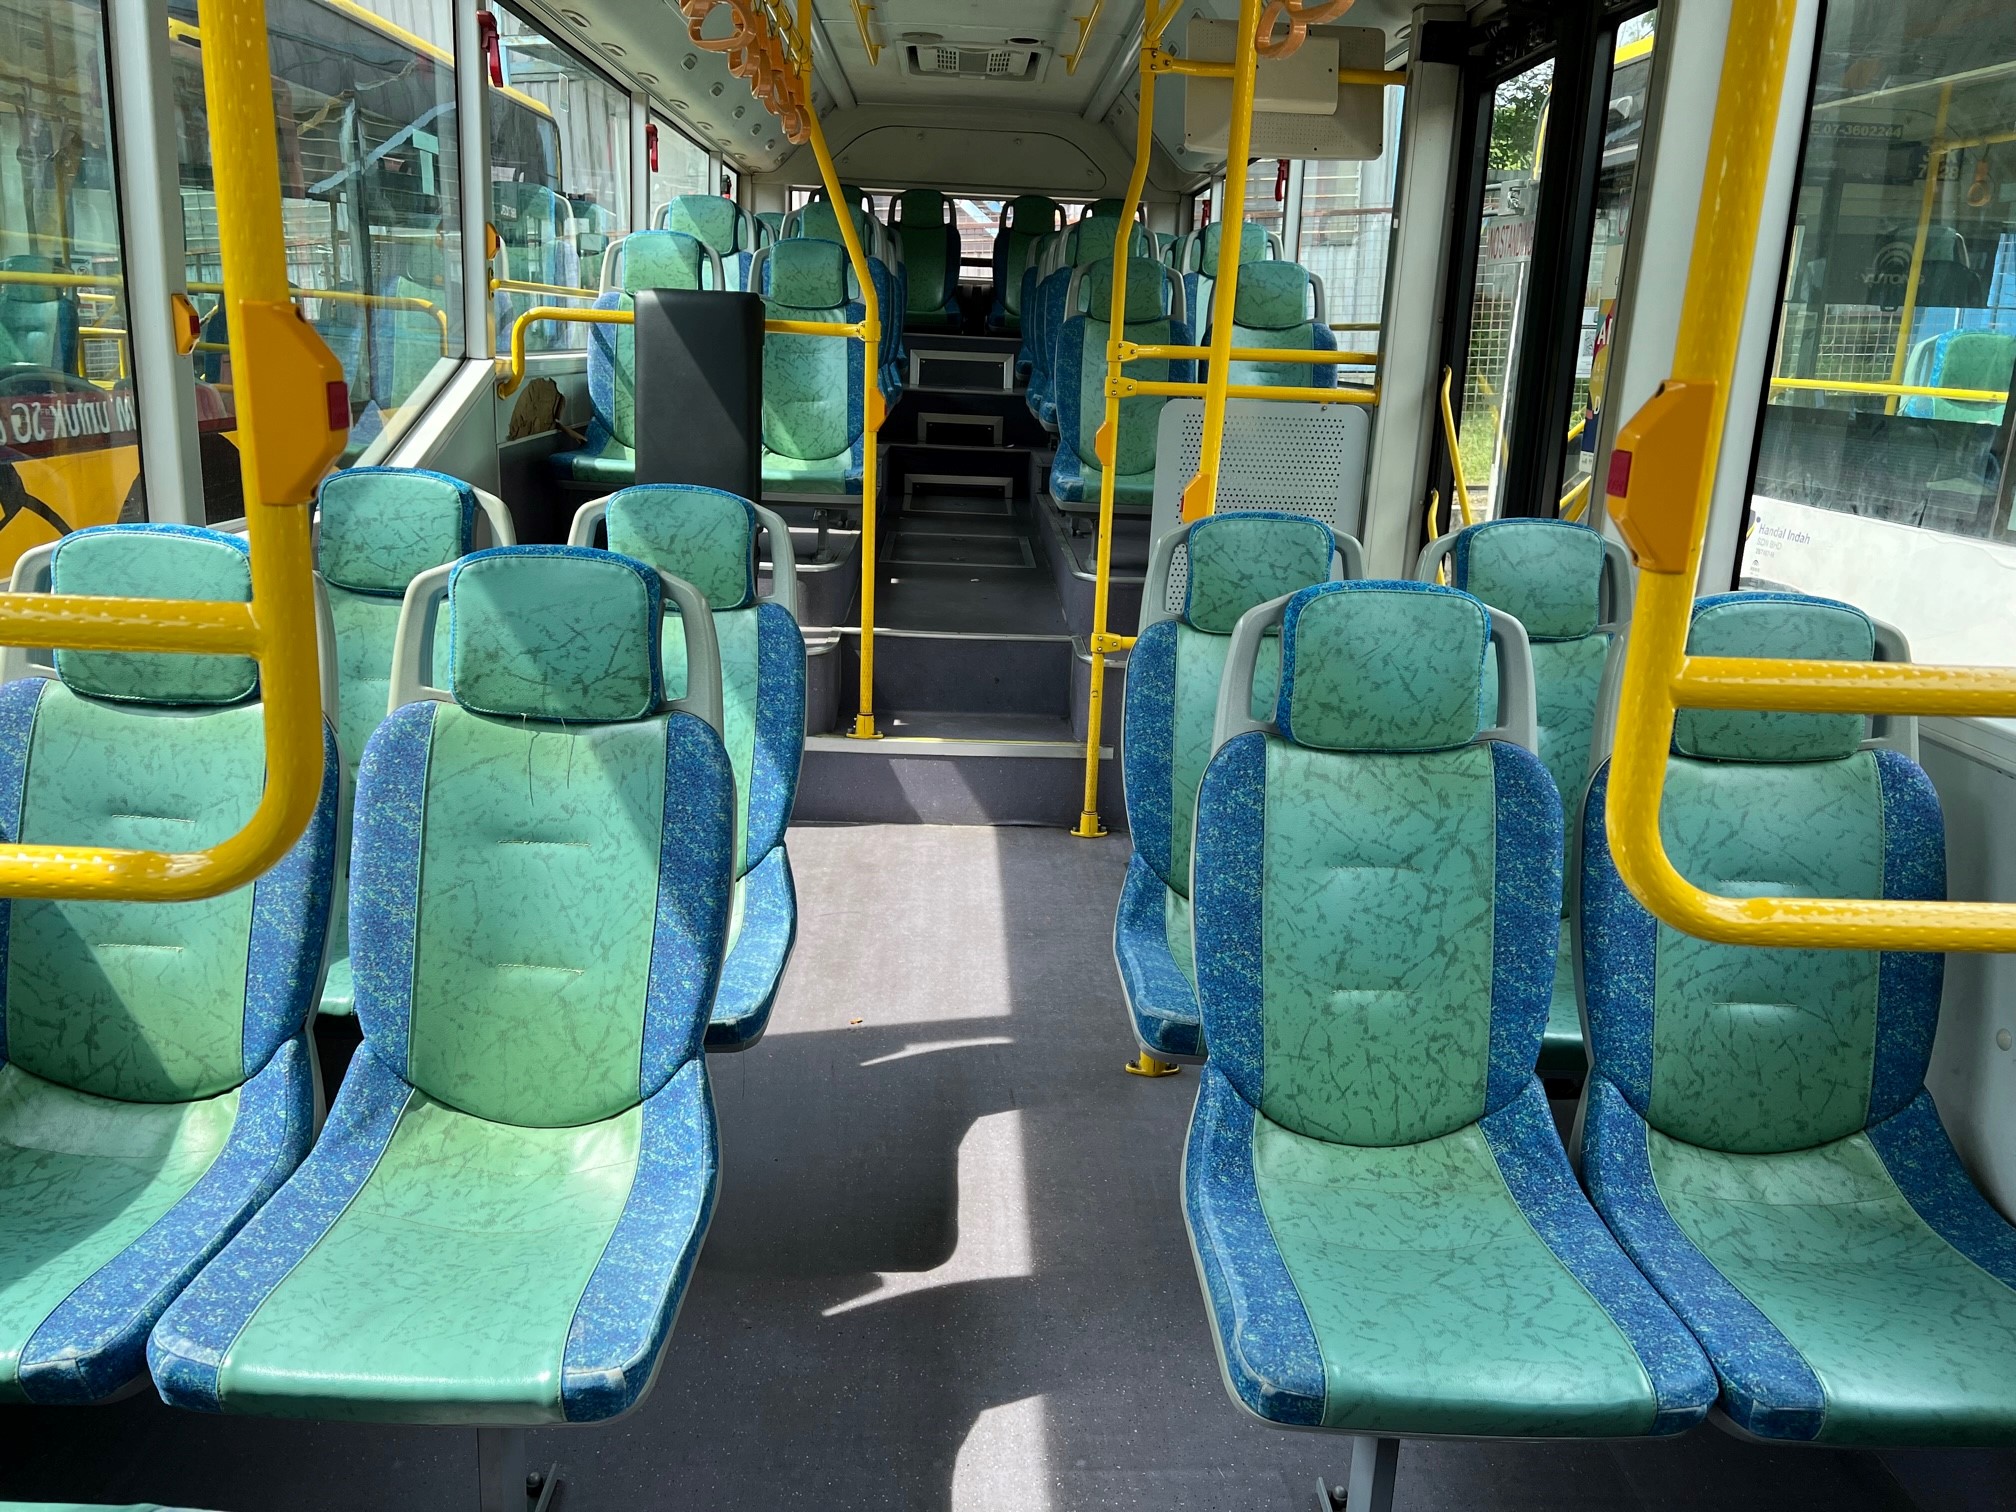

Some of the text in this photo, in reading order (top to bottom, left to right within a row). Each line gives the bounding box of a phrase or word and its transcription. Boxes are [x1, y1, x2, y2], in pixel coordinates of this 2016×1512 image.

[1861, 273, 1926, 285] YUTOG
[1759, 523, 1811, 545] Handal Indah
